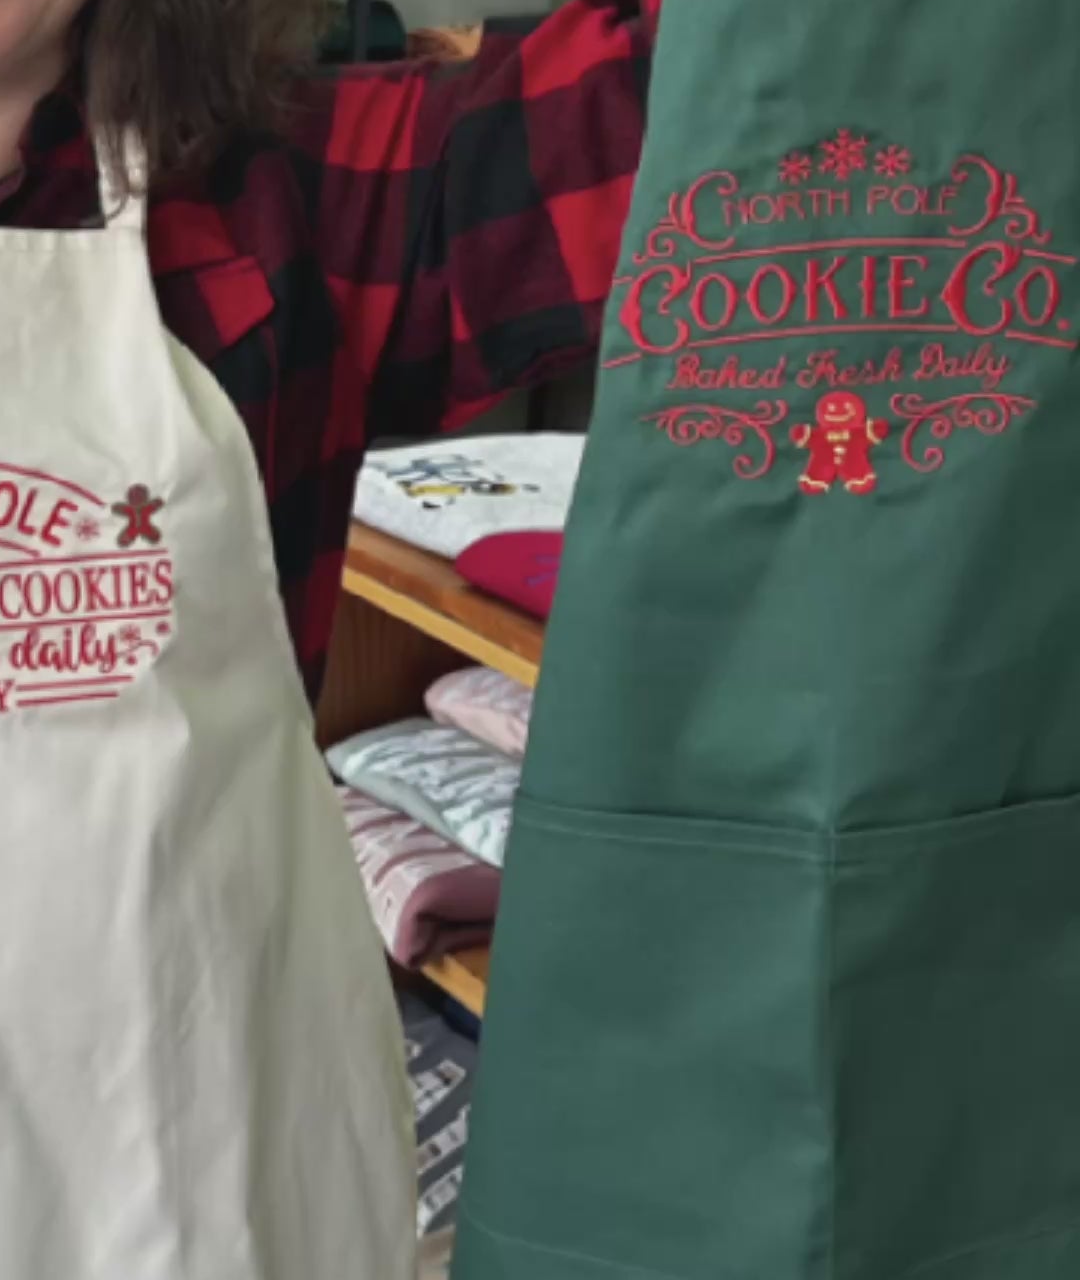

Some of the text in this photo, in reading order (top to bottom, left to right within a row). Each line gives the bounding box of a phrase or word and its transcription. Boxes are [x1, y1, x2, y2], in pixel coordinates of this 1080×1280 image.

[723, 184, 959, 228] NORTH POLE
[620, 255, 930, 354] COOKIE
[668, 341, 1014, 390] Baked Fresh Daily
[8, 624, 120, 676] daily
